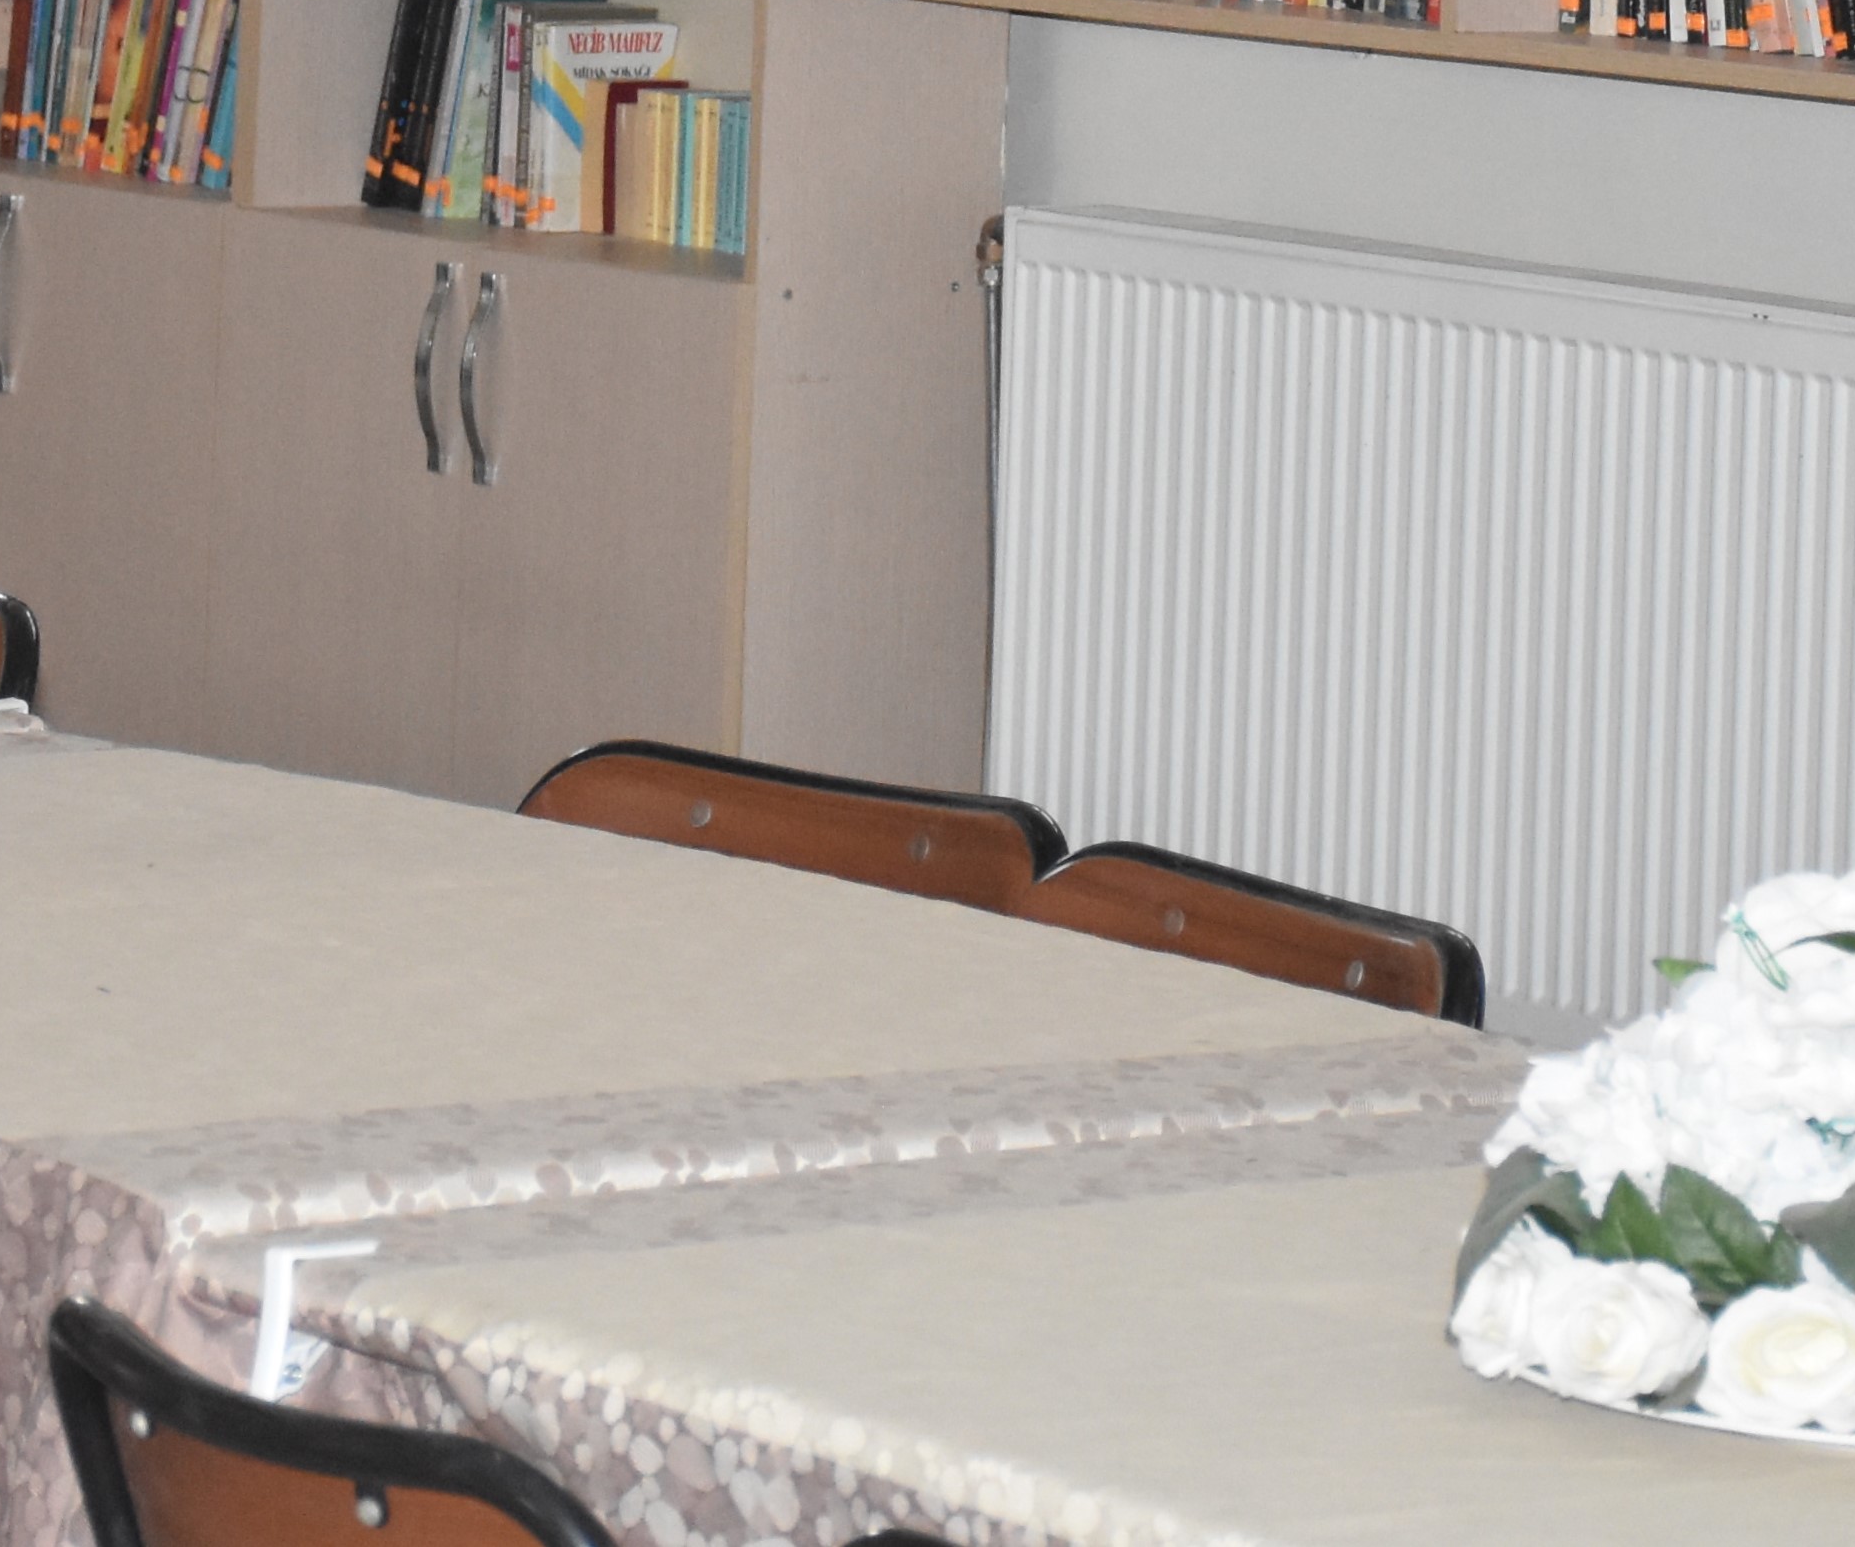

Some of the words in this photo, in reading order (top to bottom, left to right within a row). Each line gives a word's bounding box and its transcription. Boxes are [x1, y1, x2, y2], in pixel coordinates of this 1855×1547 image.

[568, 29, 604, 54] NECİB
[609, 32, 663, 53] MAHFUZ
[574, 66, 606, 78] MİDAK
[610, 66, 652, 78] SOKAĞI
